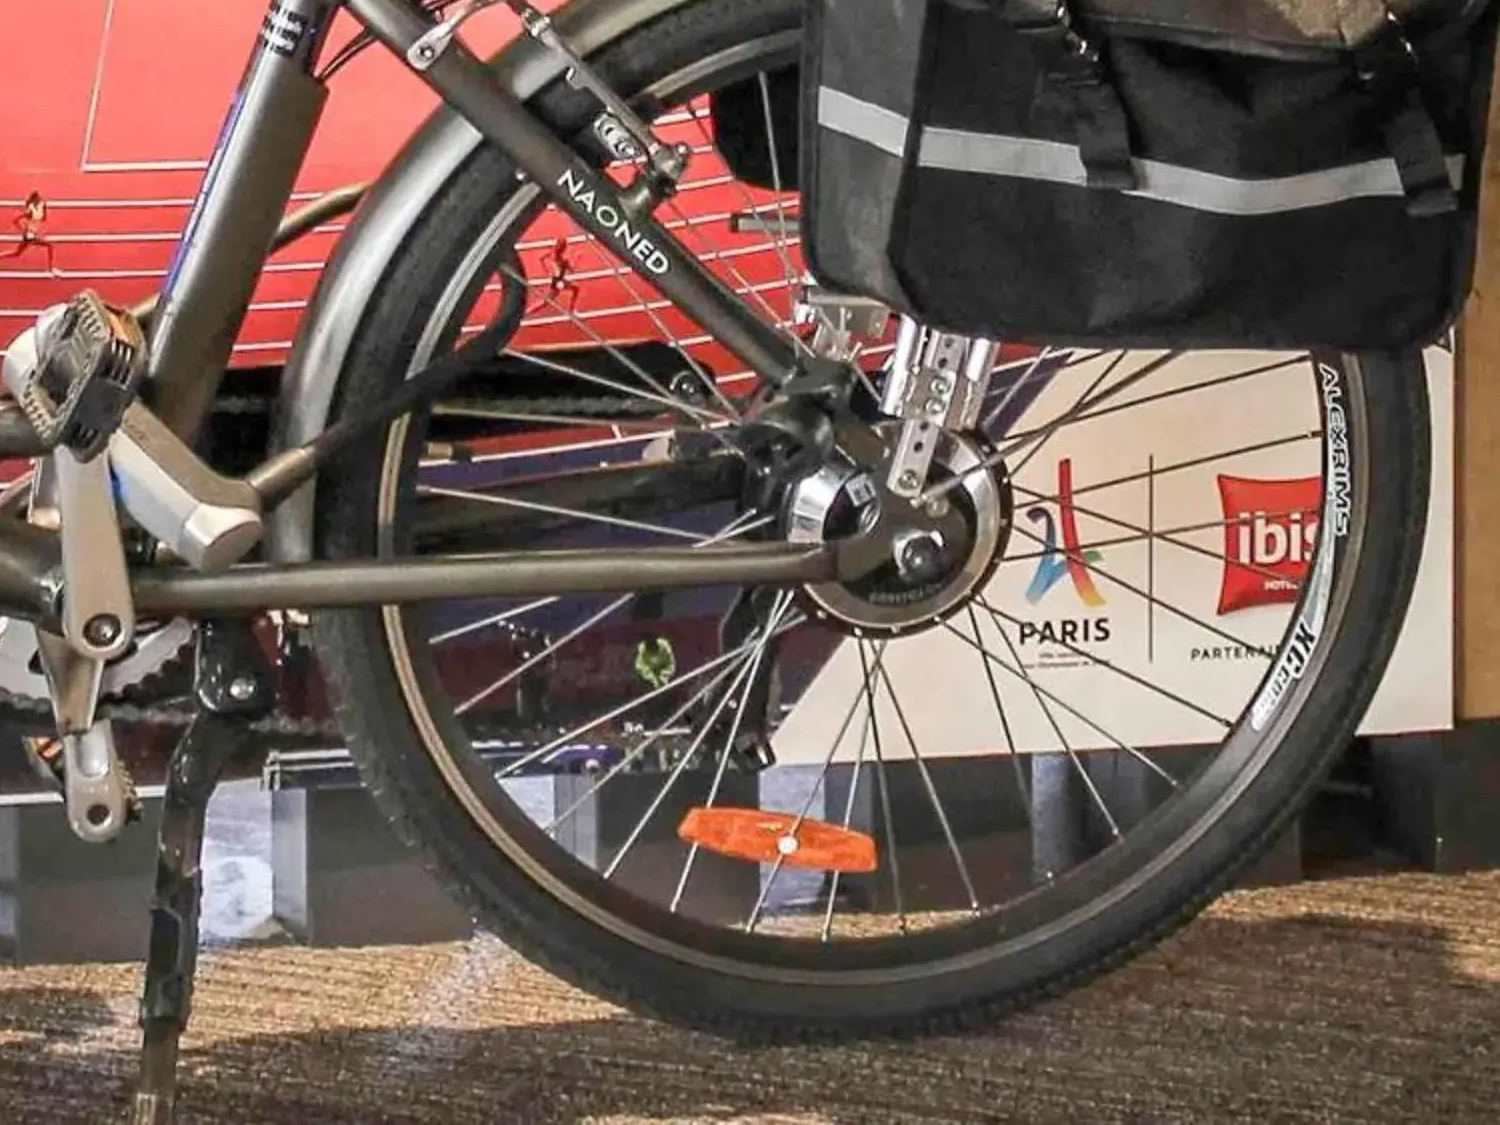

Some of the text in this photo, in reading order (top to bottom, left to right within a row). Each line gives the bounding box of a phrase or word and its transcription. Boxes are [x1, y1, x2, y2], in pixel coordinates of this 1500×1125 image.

[557, 170, 669, 275] NAONED
[1318, 363, 1351, 537] ALEXRIMS
[1019, 617, 1111, 647] PARIS
